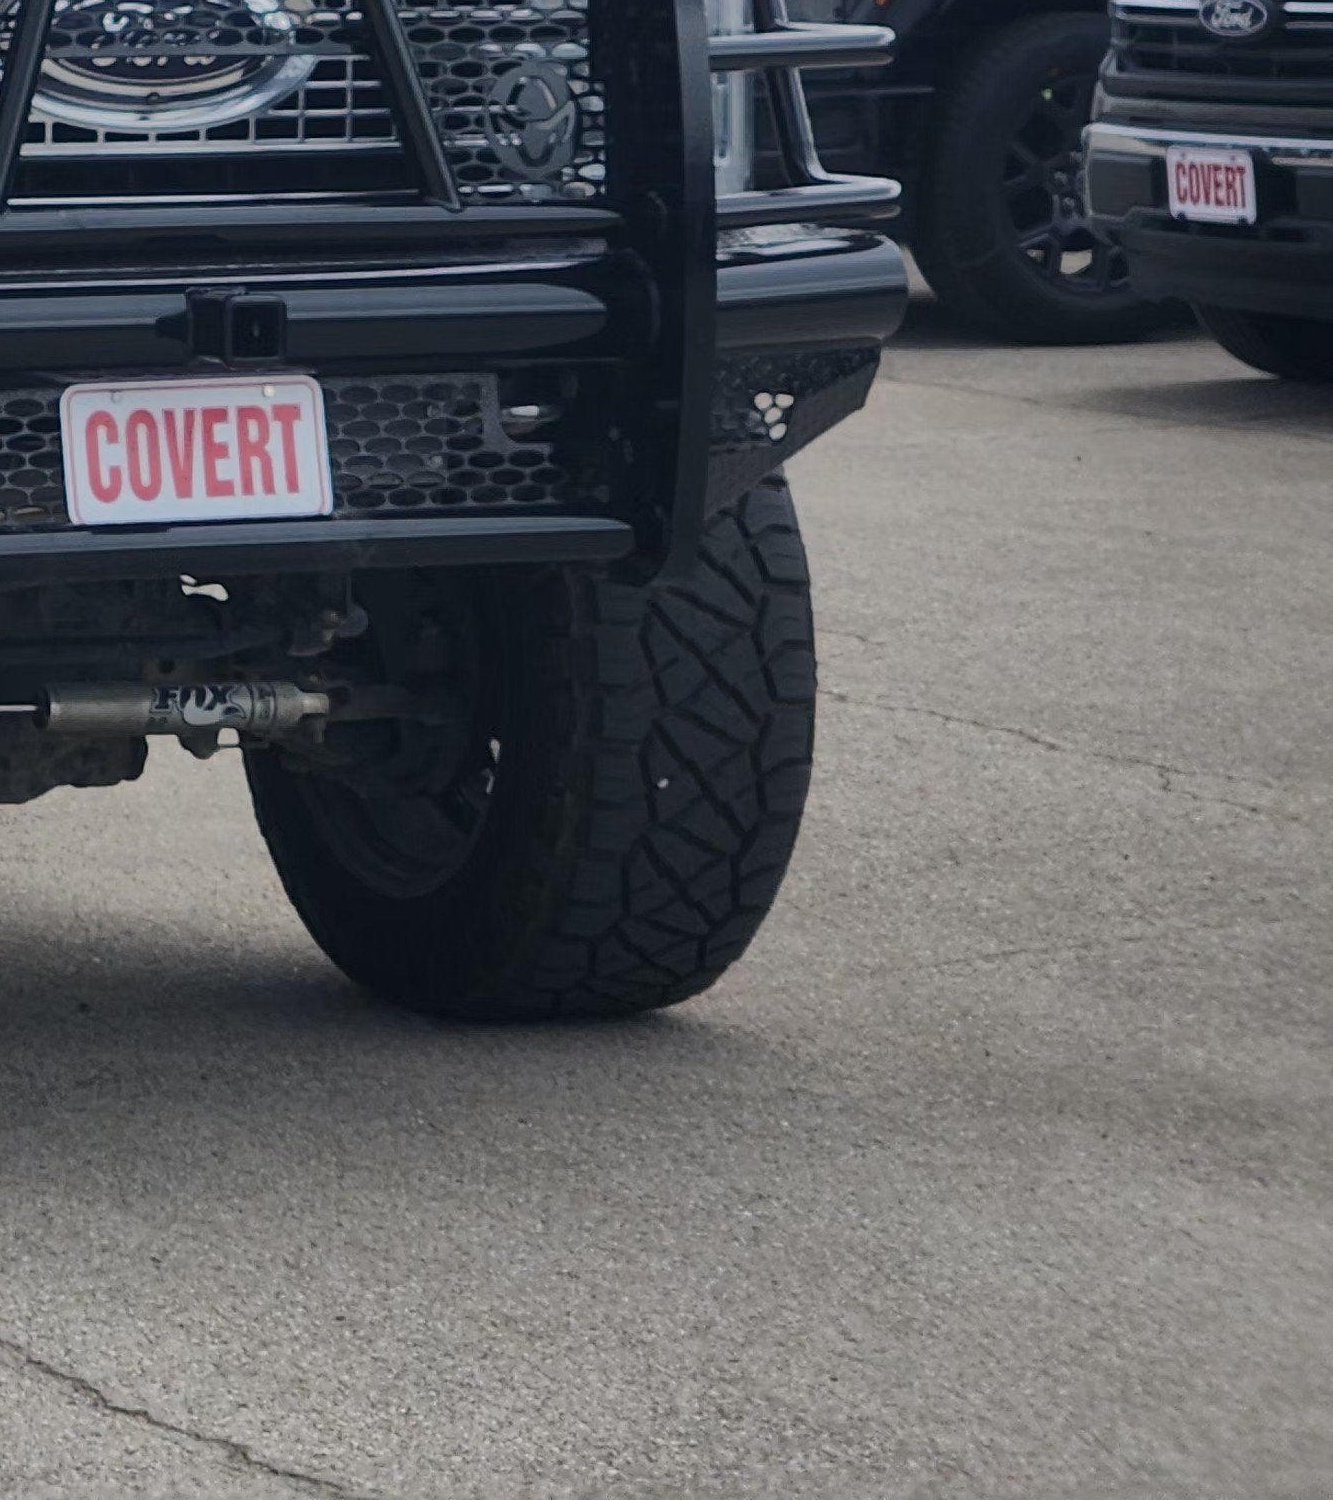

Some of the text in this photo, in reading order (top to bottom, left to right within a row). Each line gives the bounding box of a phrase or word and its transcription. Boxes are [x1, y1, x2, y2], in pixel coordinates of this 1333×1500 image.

[1175, 162, 1246, 208] COVERT
[85, 404, 301, 504] COVERT
[149, 684, 246, 725] FOX
